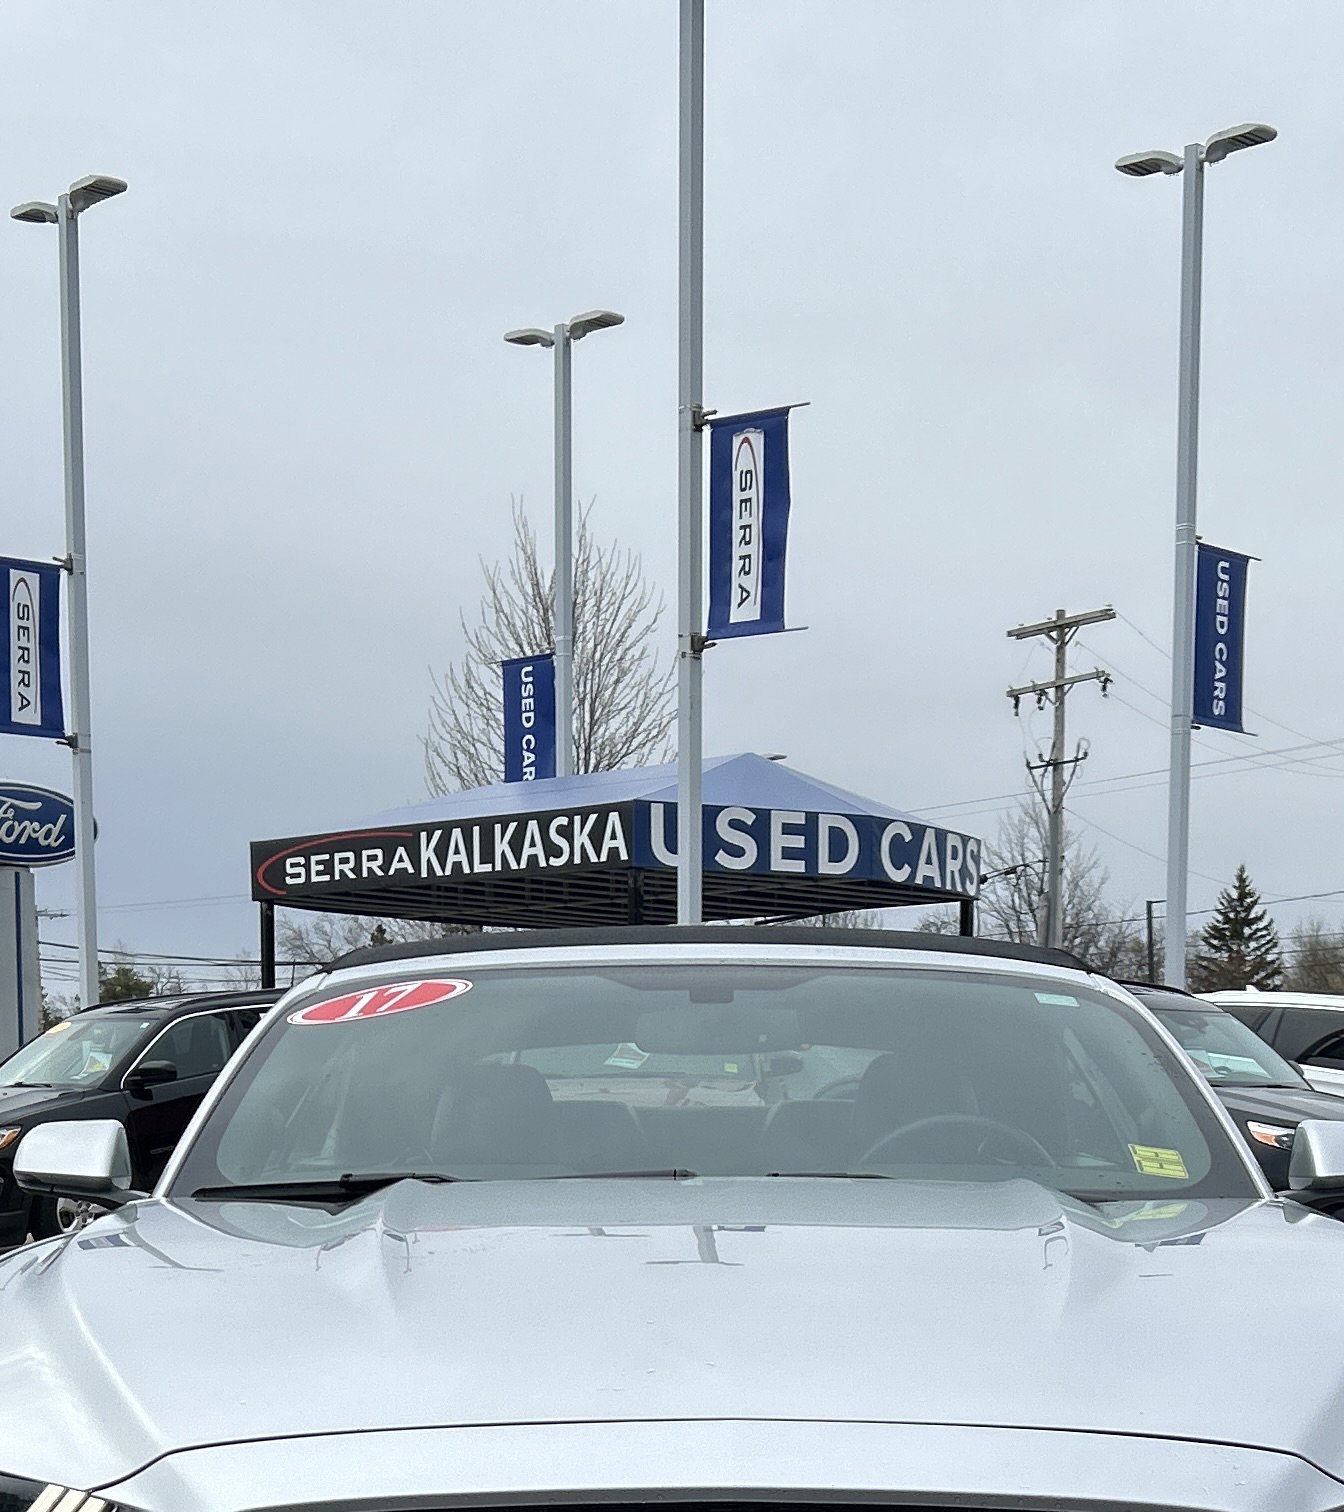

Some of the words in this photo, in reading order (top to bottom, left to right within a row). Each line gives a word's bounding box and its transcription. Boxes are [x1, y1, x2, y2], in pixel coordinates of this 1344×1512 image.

[738, 469, 754, 608] SERRA
[1216, 561, 1230, 634] USED
[17, 602, 31, 711] SERRA
[1213, 643, 1228, 716] CARS
[520, 666, 535, 728] USED
[521, 734, 536, 781] CAR
[285, 845, 416, 885] SERRA
[419, 811, 630, 878] KALKASKA
[650, 802, 860, 876] USED
[880, 821, 981, 897] CARS
[341, 983, 422, 1018] 17
